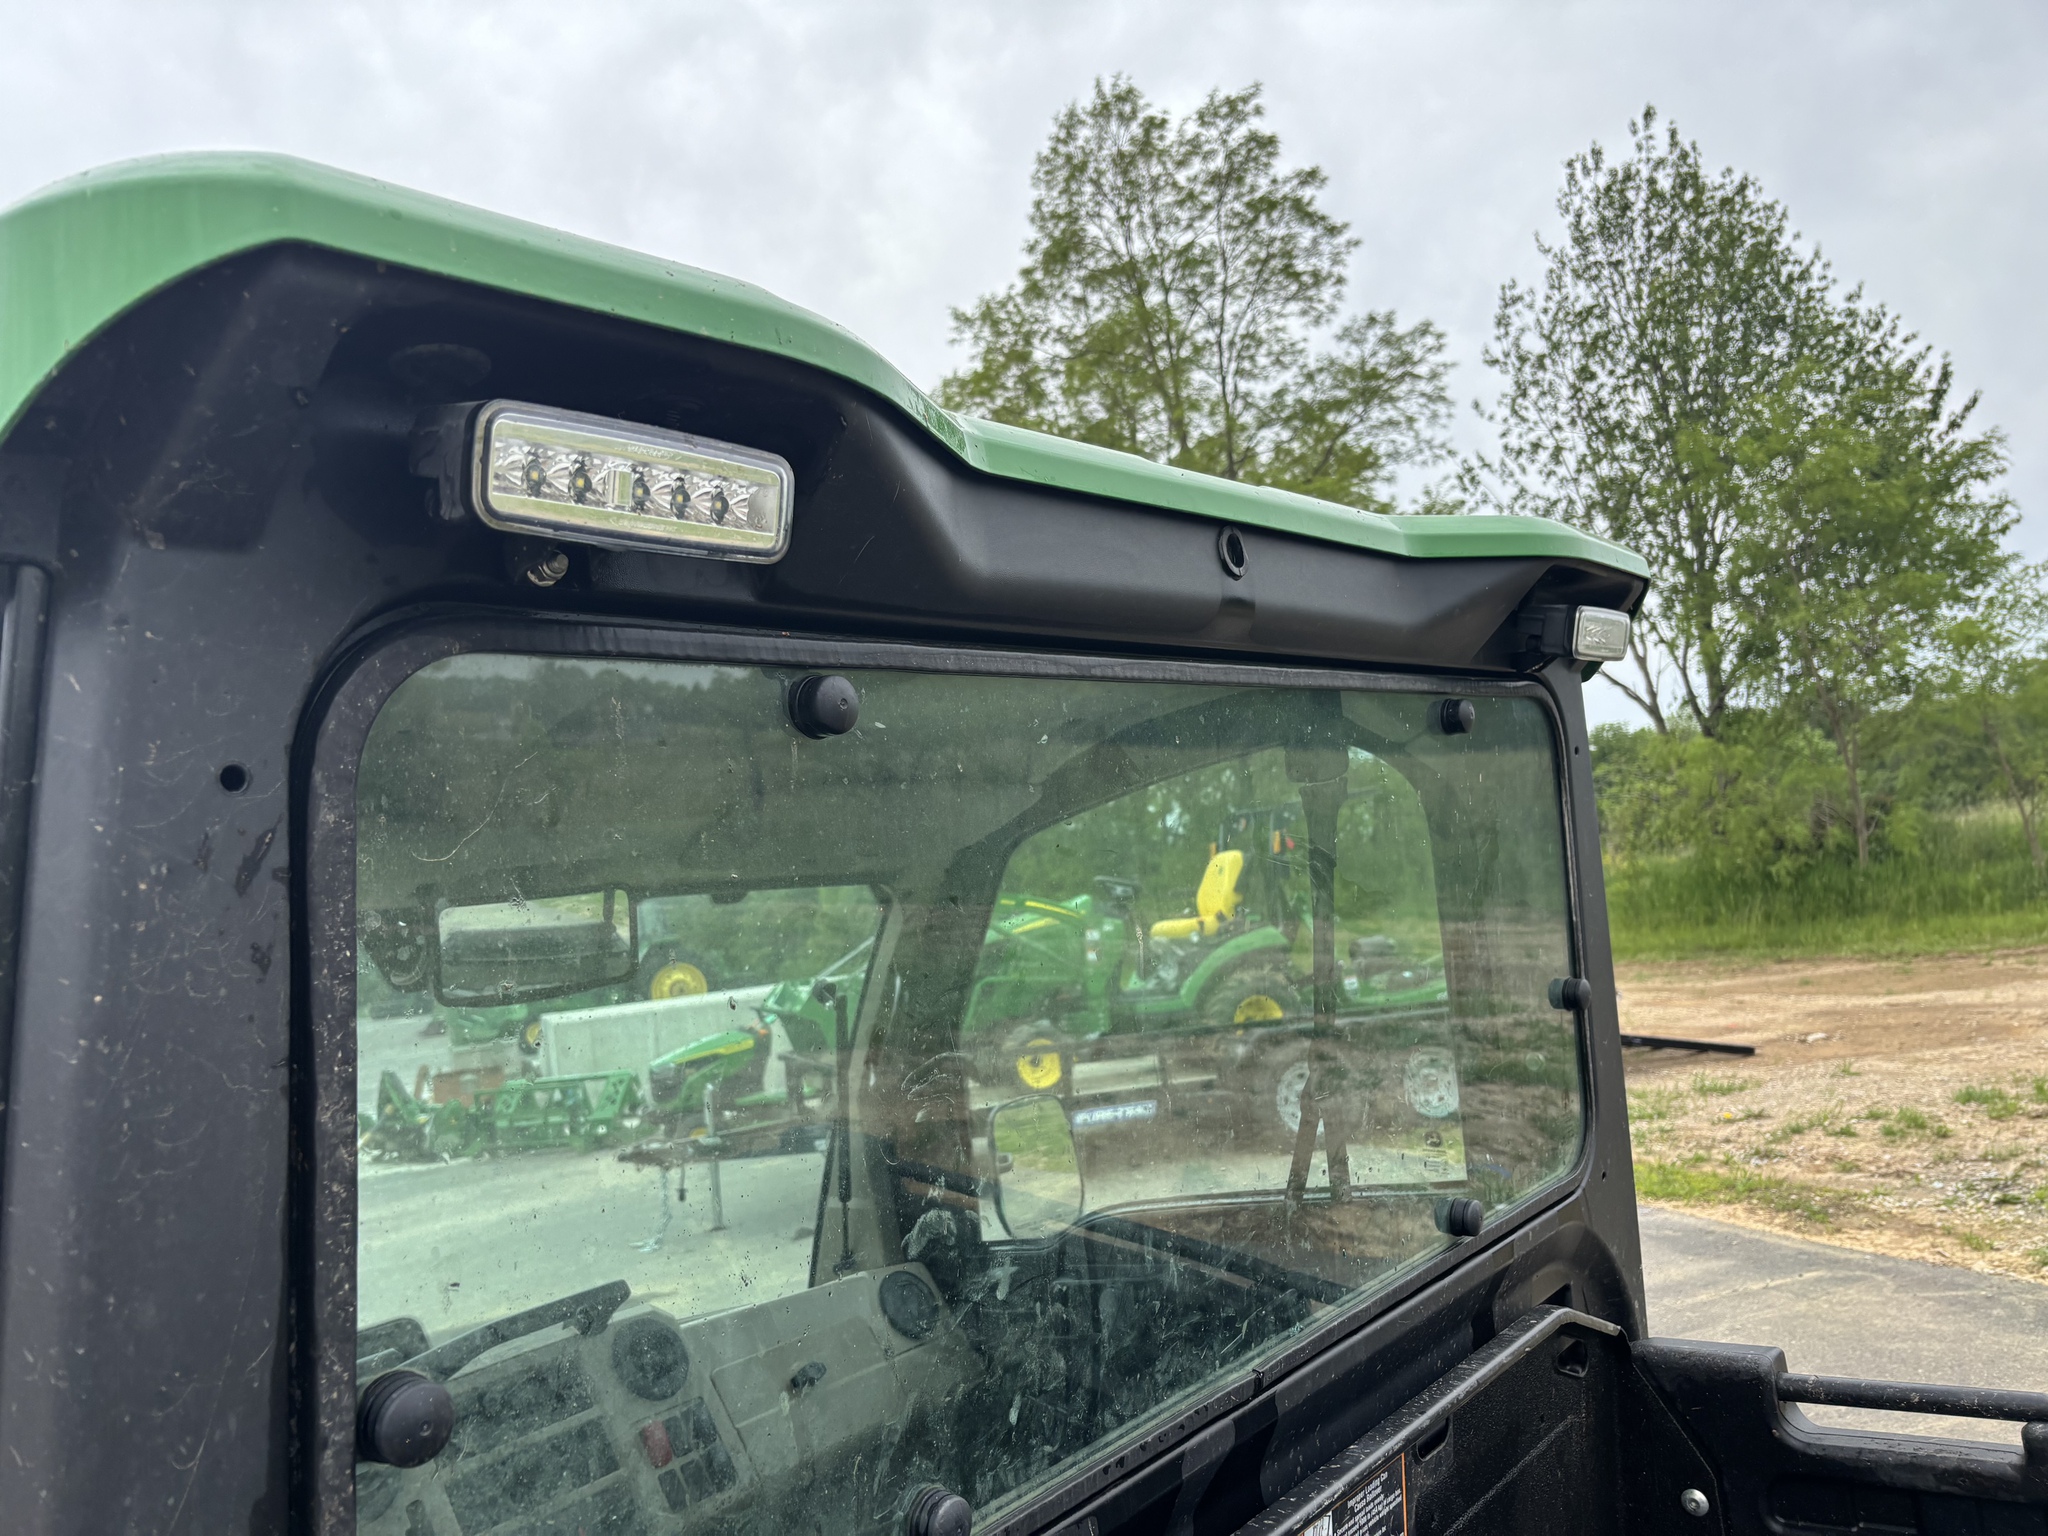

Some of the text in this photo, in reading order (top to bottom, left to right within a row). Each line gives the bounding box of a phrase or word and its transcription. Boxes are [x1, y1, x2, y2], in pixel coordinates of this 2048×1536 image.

[1348, 1472, 1388, 1508] Improper Loading Can
[1354, 1486, 1382, 1512] Cause Rollover
[1336, 1523, 1348, 1536] Secure
[1355, 1508, 1365, 1522] spread
